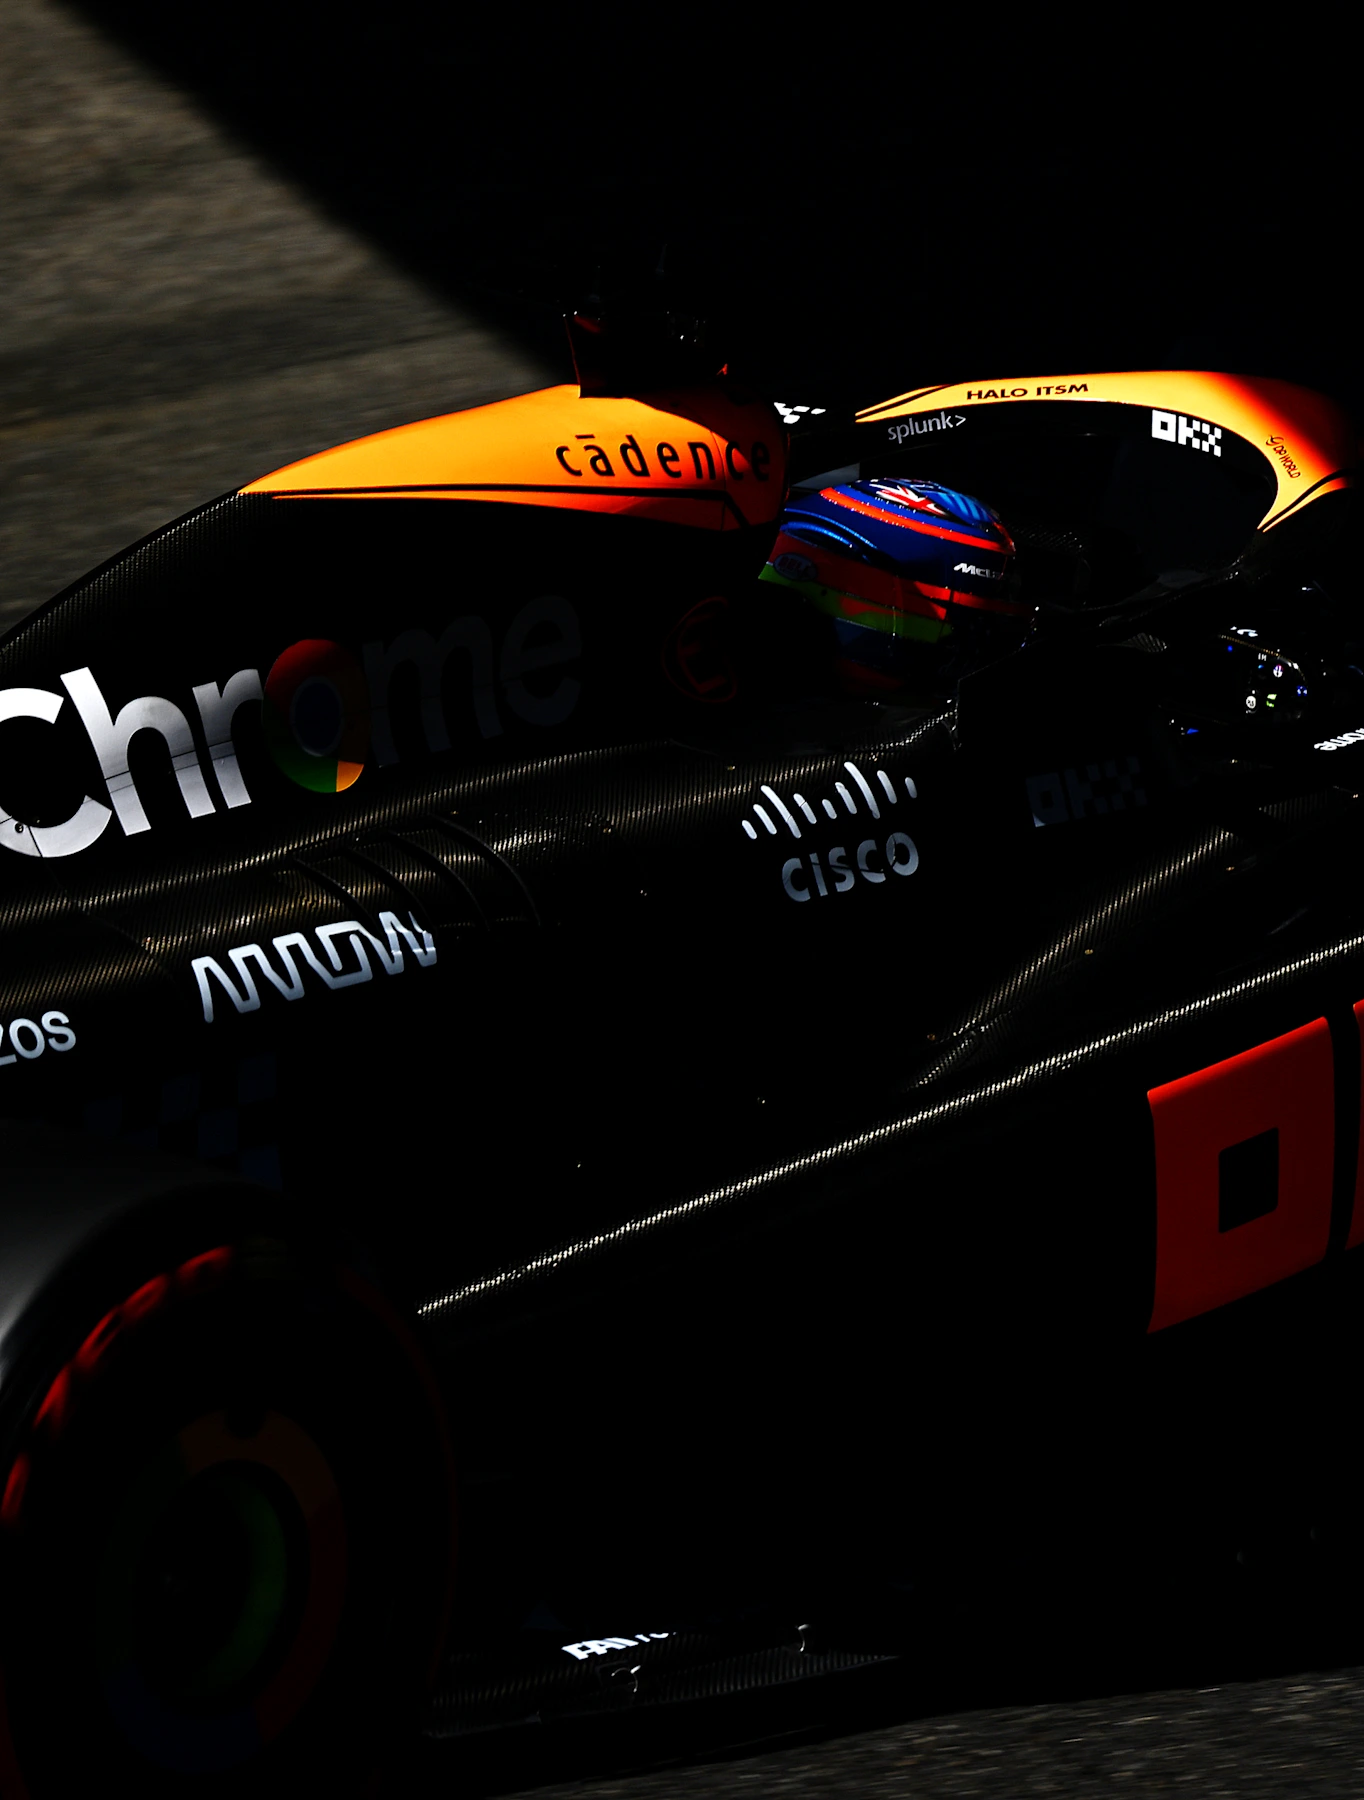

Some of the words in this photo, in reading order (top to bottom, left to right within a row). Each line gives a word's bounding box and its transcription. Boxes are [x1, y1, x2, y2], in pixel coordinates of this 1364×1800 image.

[967, 388, 1028, 400] HALO
[1036, 383, 1089, 396] ITSM
[1151, 409, 1222, 457] OKX
[1024, 756, 1149, 828] OKX
